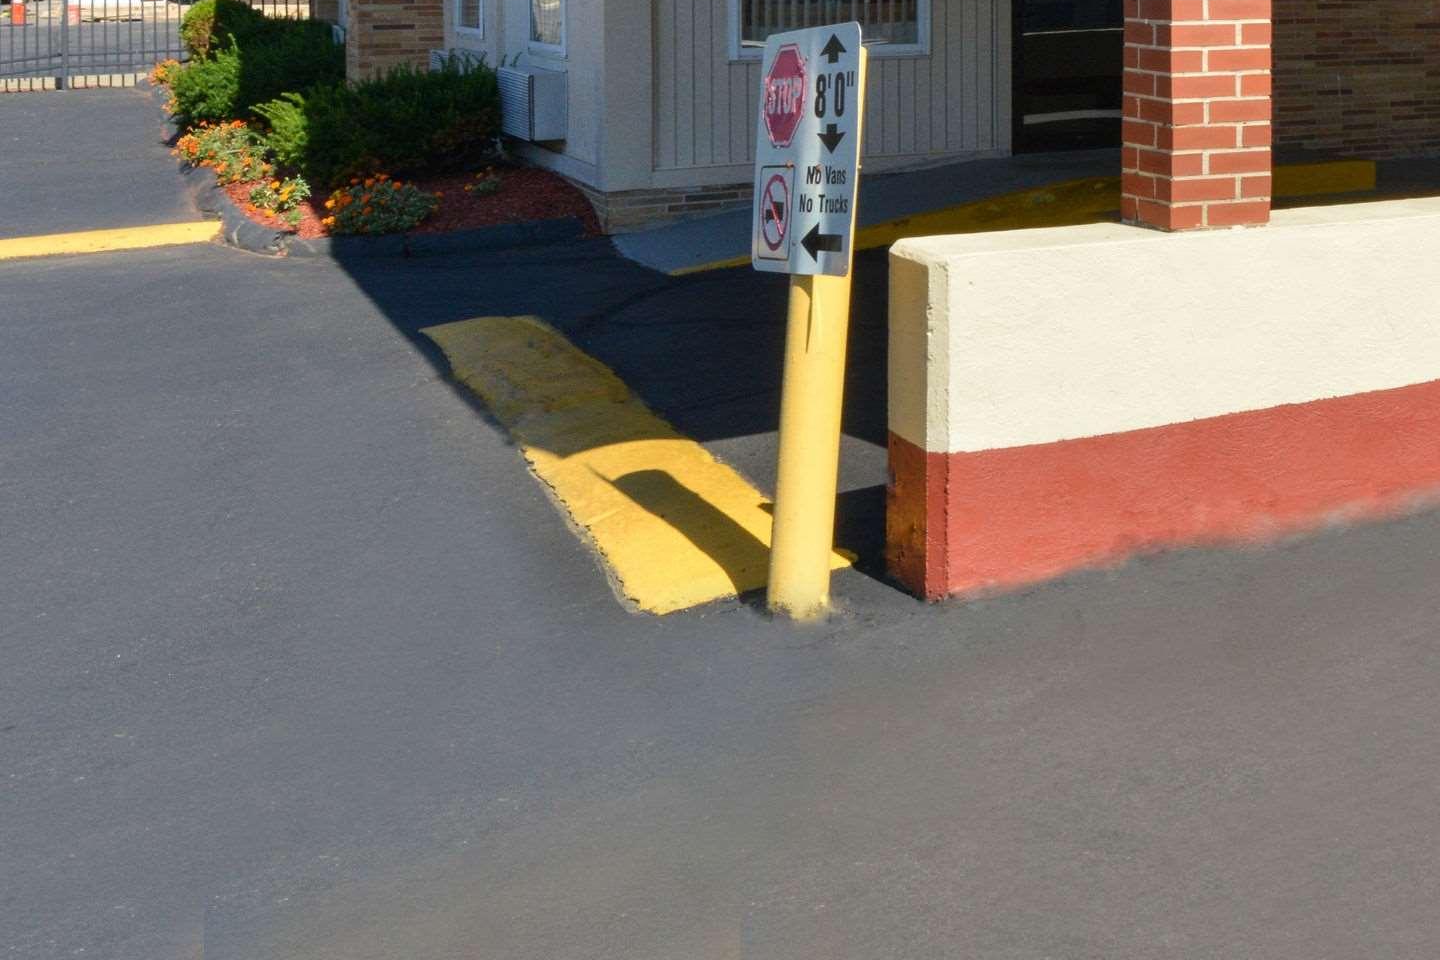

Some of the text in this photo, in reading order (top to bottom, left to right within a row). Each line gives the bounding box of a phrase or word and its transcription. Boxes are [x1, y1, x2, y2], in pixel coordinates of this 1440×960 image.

[767, 77, 802, 114] STOP
[806, 165, 847, 185] No Vans
[799, 193, 849, 214] No Trucks
